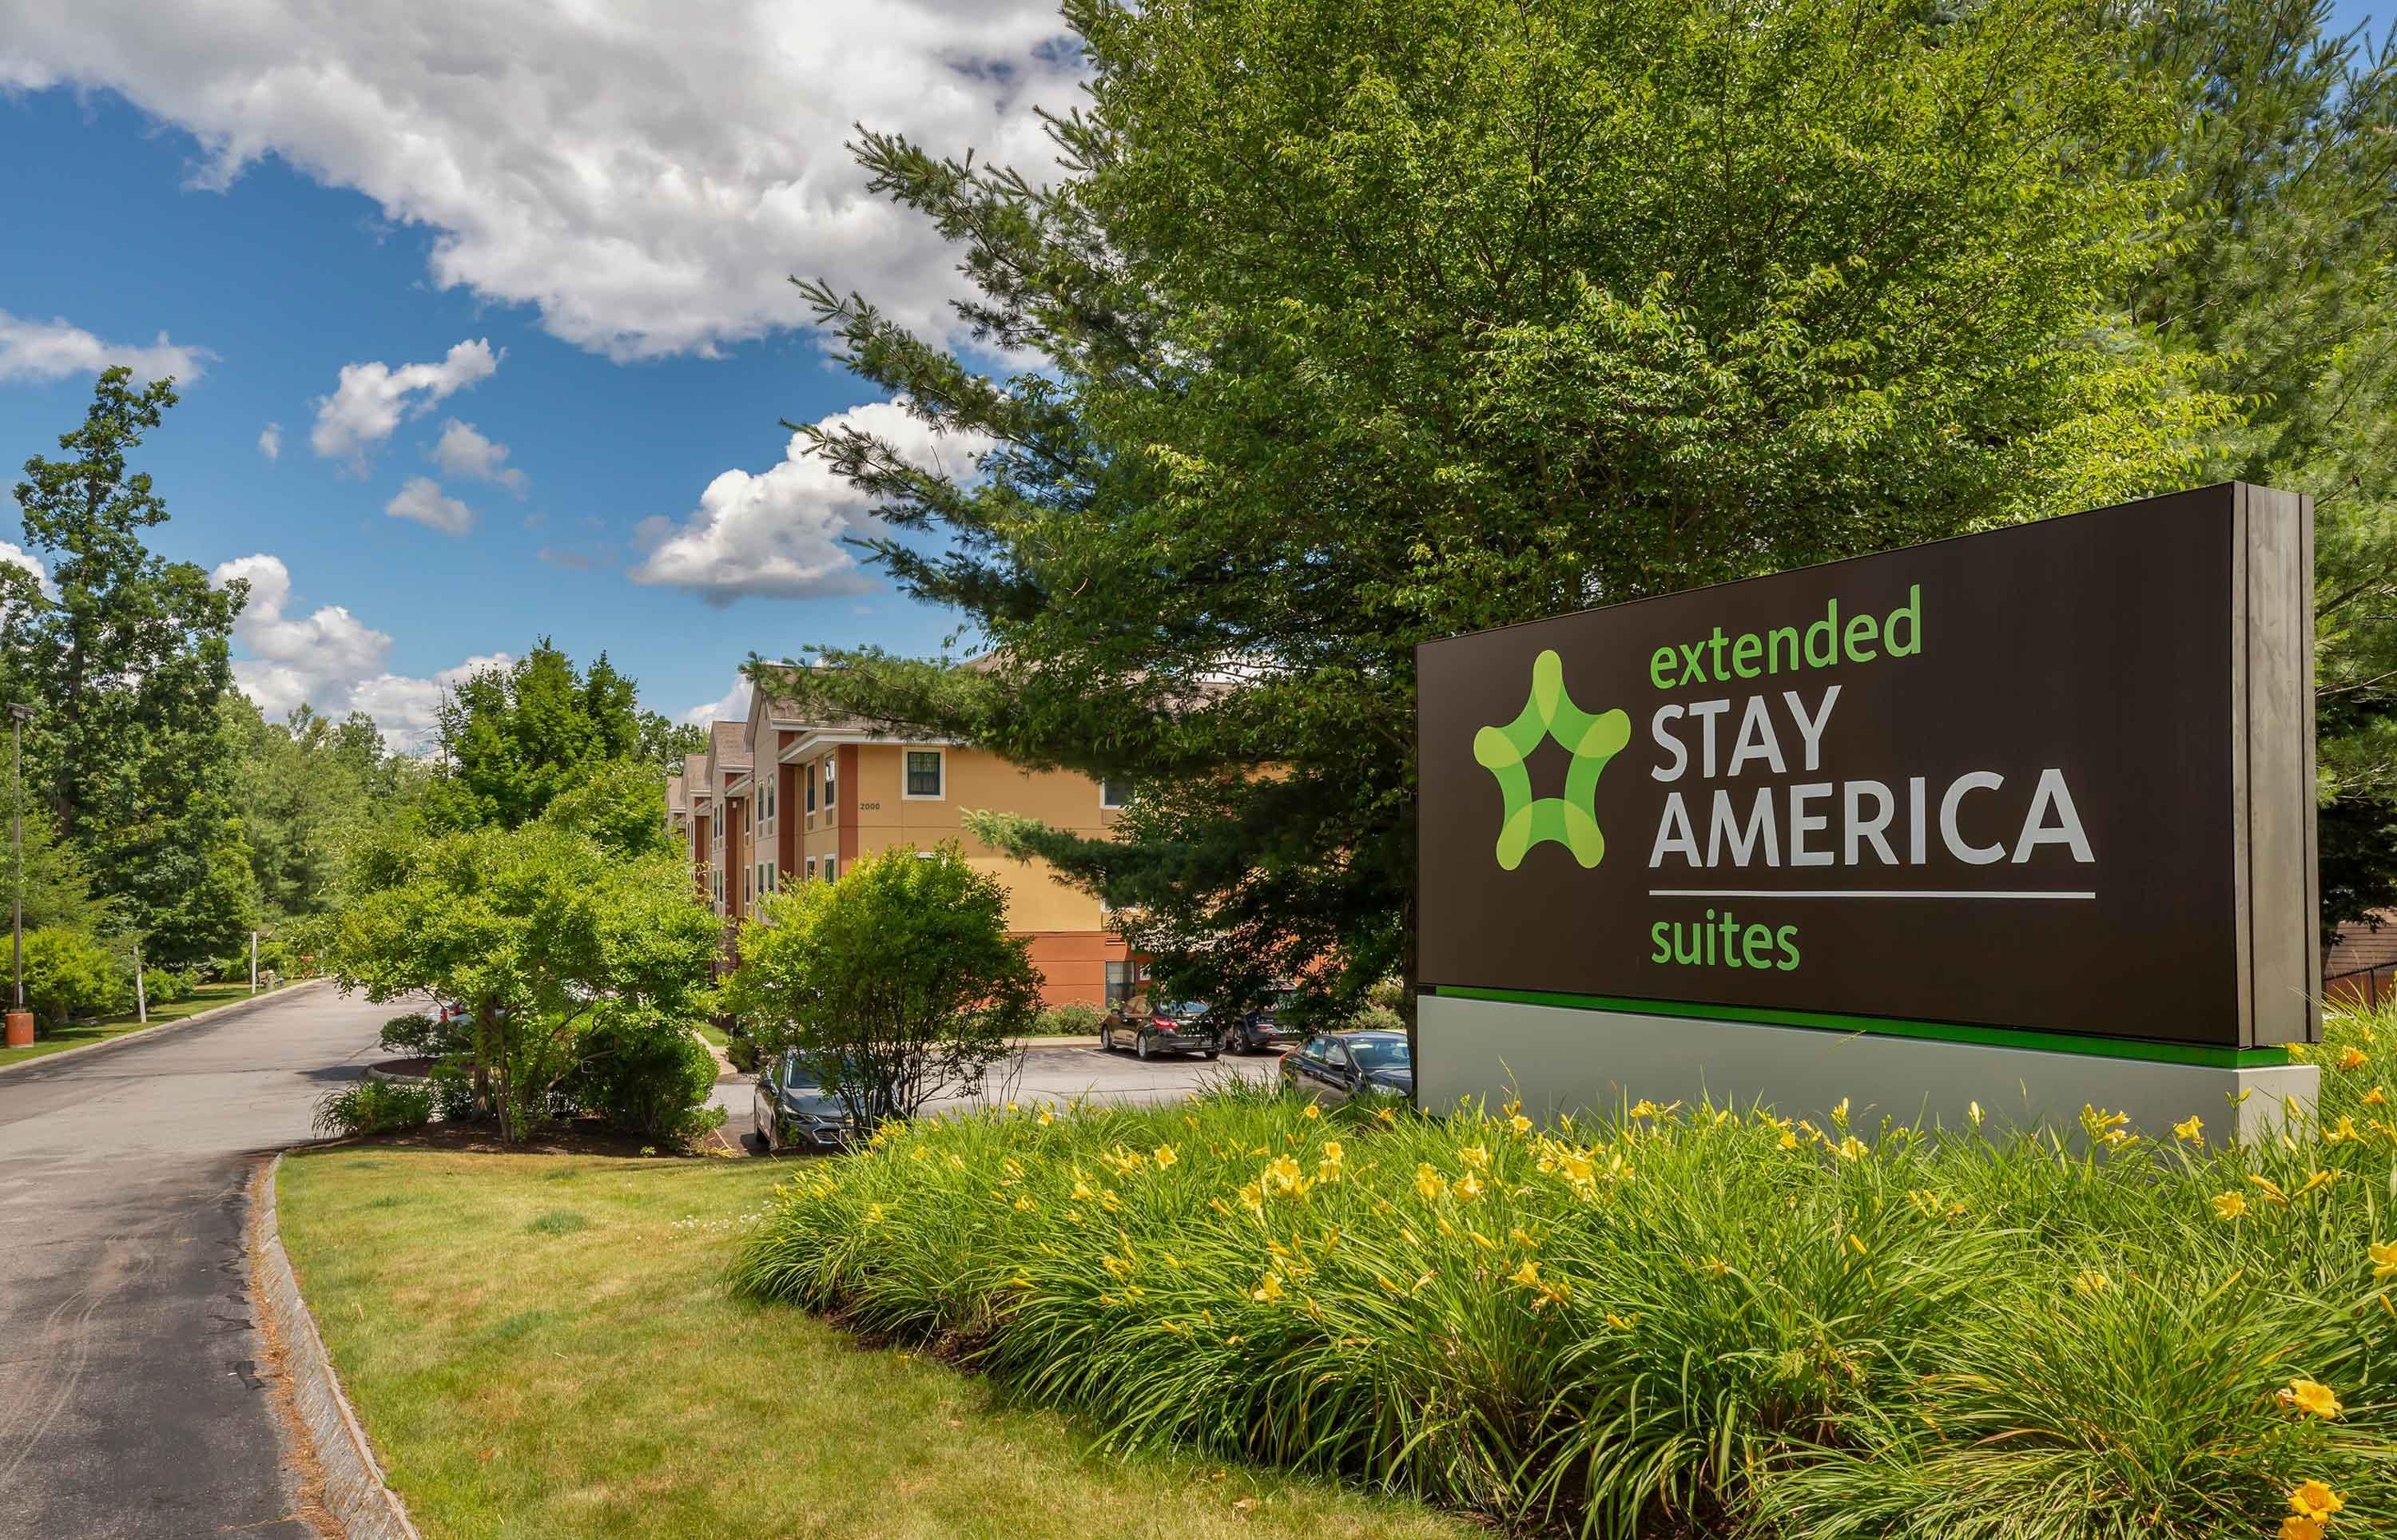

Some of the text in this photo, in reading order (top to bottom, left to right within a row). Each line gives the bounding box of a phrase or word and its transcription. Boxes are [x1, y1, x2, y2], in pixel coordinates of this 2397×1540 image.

[1650, 584, 1921, 689] extended
[1651, 685, 1842, 783] STAY
[1648, 768, 2096, 868] AMERICA
[1651, 909, 1801, 971] suites
